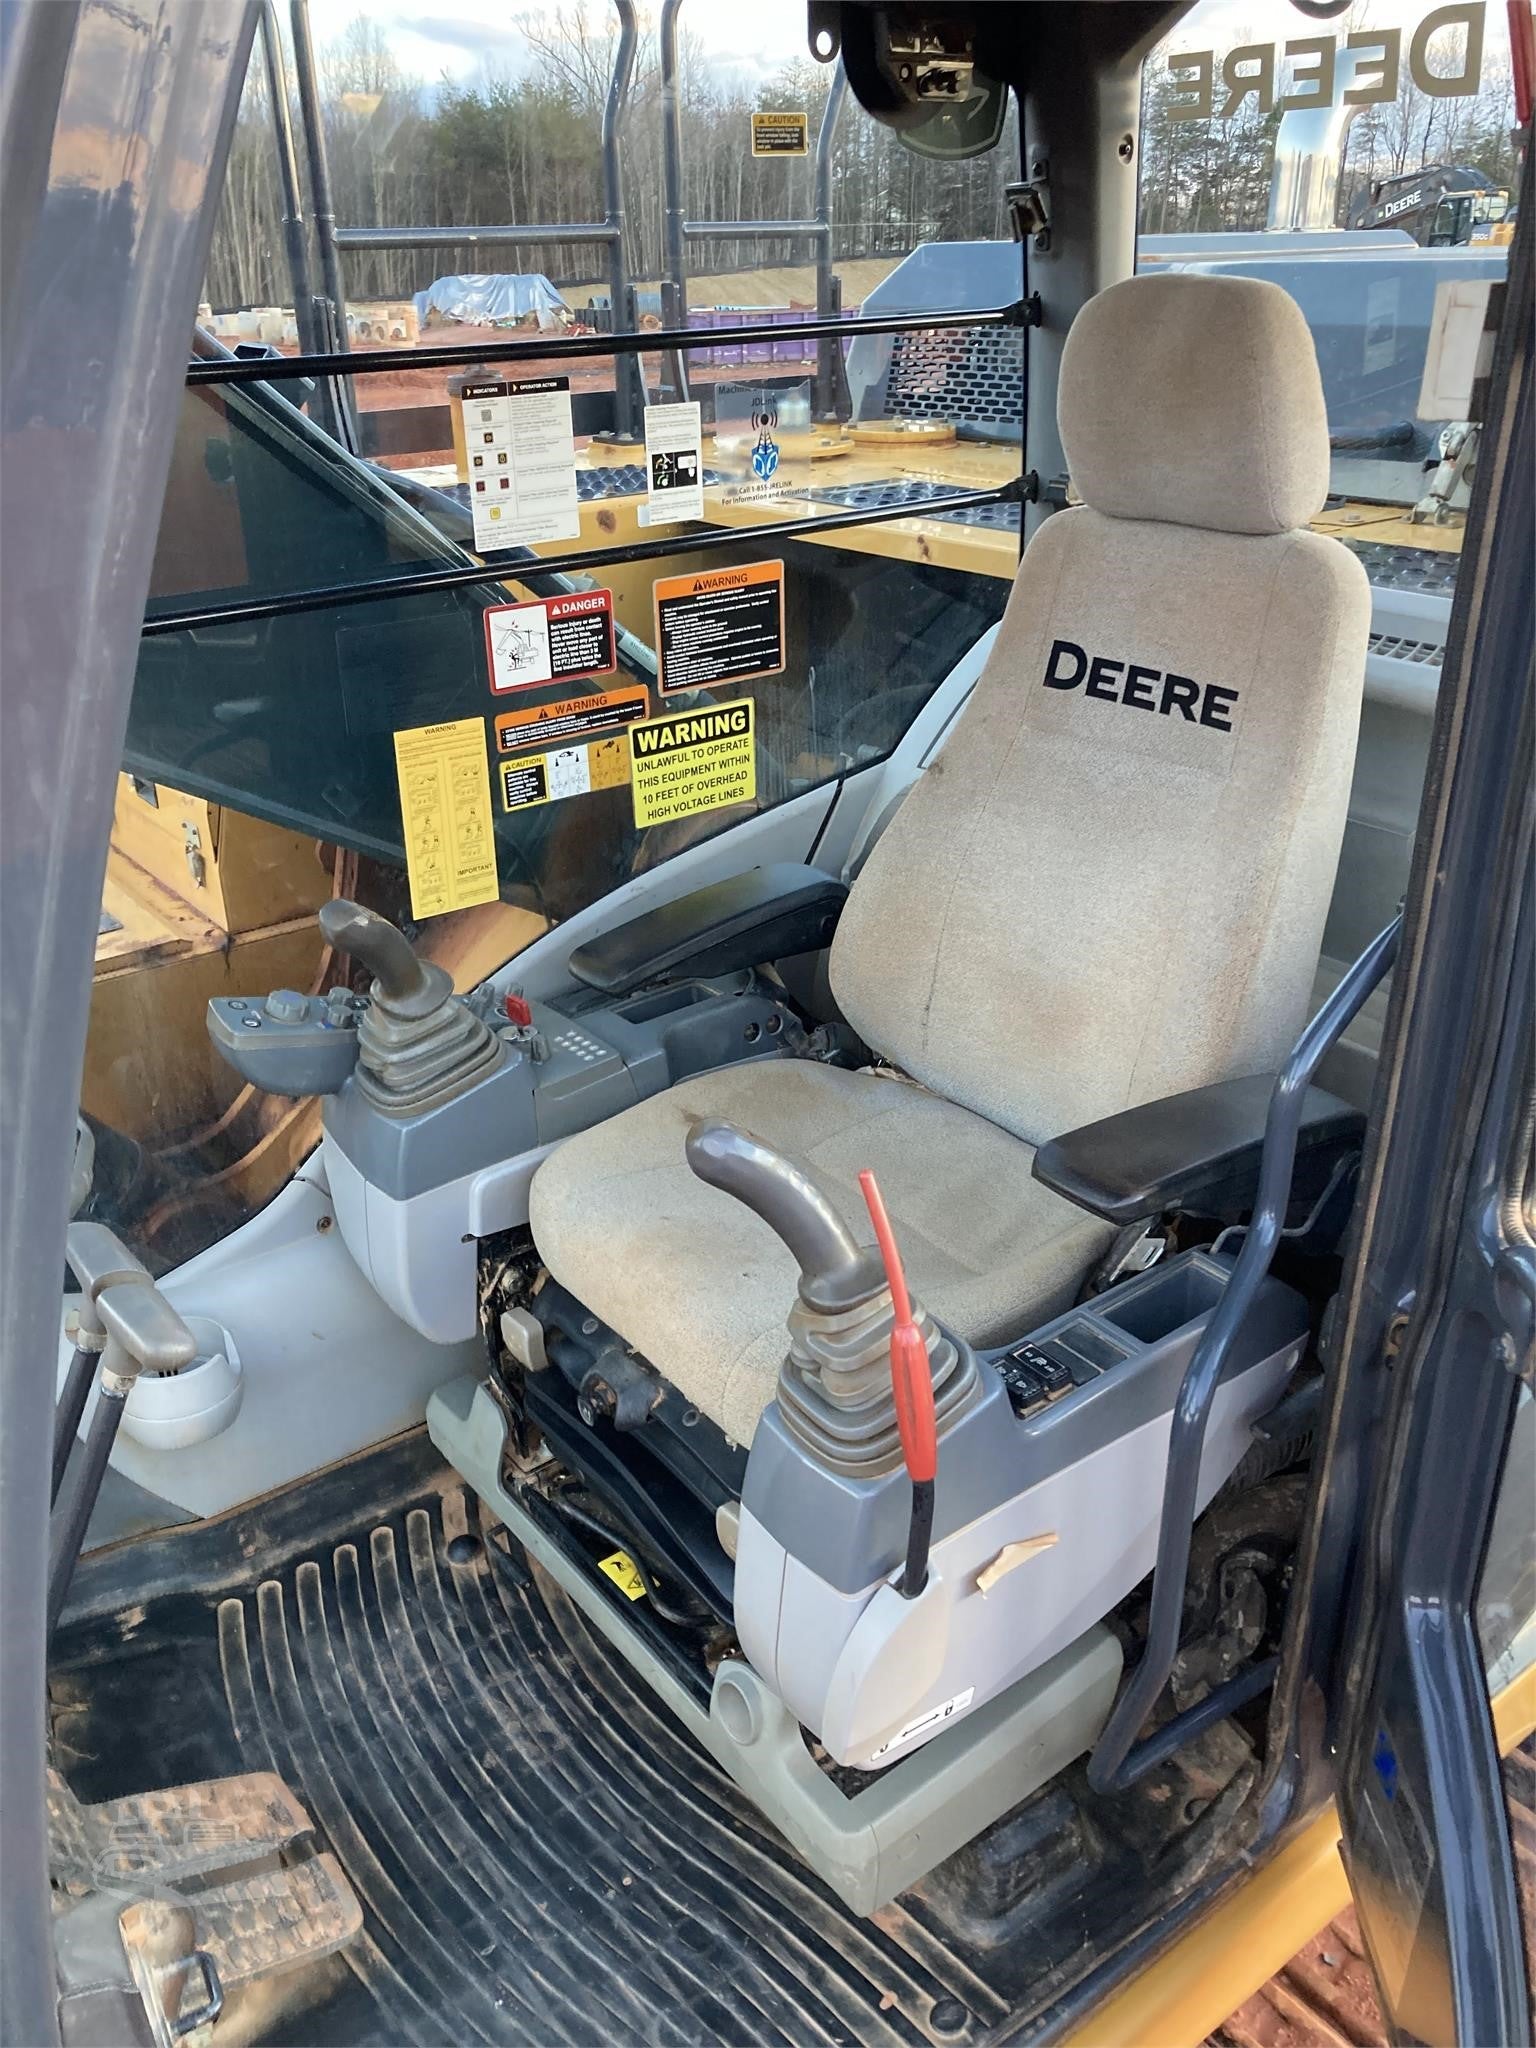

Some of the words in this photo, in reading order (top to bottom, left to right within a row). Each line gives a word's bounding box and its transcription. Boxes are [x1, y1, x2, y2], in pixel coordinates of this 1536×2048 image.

[767, 115, 800, 124] CAUTION
[1385, 190, 1422, 218] DEERE
[473, 387, 498, 395] INDICATORS
[520, 382, 541, 390] OPERATOR
[721, 498, 732, 506] For
[732, 492, 768, 504] Information
[768, 491, 780, 499] and
[780, 487, 809, 497] Activation
[739, 485, 750, 495] Call
[702, 573, 748, 589] WARNING
[562, 597, 606, 614] DANGER
[1042, 639, 1240, 733] DEERE
[555, 695, 608, 715] WARNING
[424, 723, 457, 736] WARNING
[637, 710, 746, 753] WARNING
[511, 757, 542, 770] CAUTION
[637, 752, 690, 773] UNLAWFUL
[692, 748, 705, 760] TO
[706, 738, 750, 756] OPERATE
[638, 776, 660, 790] THIS
[661, 761, 716, 785] EQUIPMENT
[718, 754, 751, 769] WITHIN
[643, 794, 654, 805] 10
[655, 787, 680, 802] FEET
[681, 784, 695, 795] OF
[696, 770, 748, 791] OVERHEAD
[647, 805, 671, 820] HIGH
[673, 793, 717, 814] VOLTAGE
[718, 787, 745, 801] LINES
[457, 863, 493, 877] IMPORTANT
